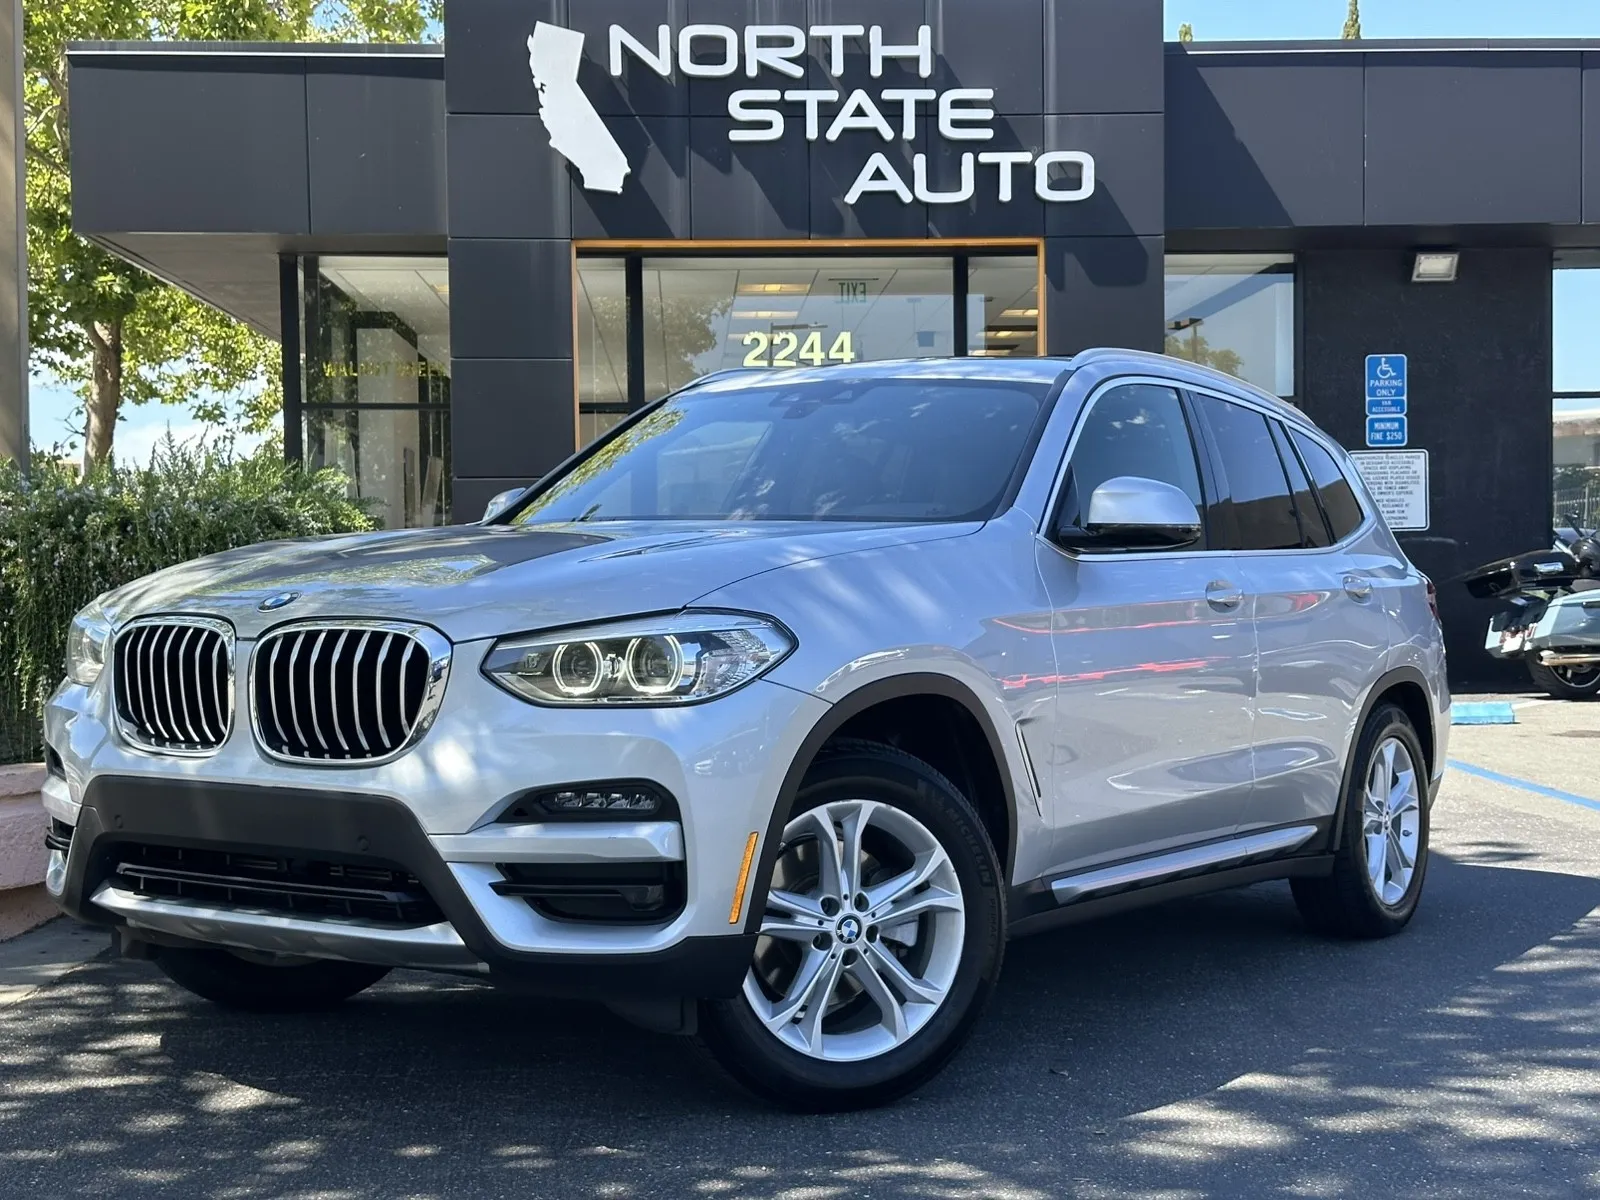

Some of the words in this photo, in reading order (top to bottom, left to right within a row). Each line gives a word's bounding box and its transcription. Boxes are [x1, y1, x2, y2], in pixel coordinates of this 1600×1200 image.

[608, 24, 931, 78] NORTH
[727, 89, 995, 142] STATE
[843, 151, 1095, 204] AUTO
[742, 331, 855, 367] 2244
[1369, 379, 1403, 387] PARKING
[1376, 388, 1396, 396] ONLY
[1370, 431, 1384, 440] FINE
[1386, 431, 1403, 440] $250
[1374, 421, 1399, 430] MINIMUM
[946, 807, 993, 884] MICHELIN
